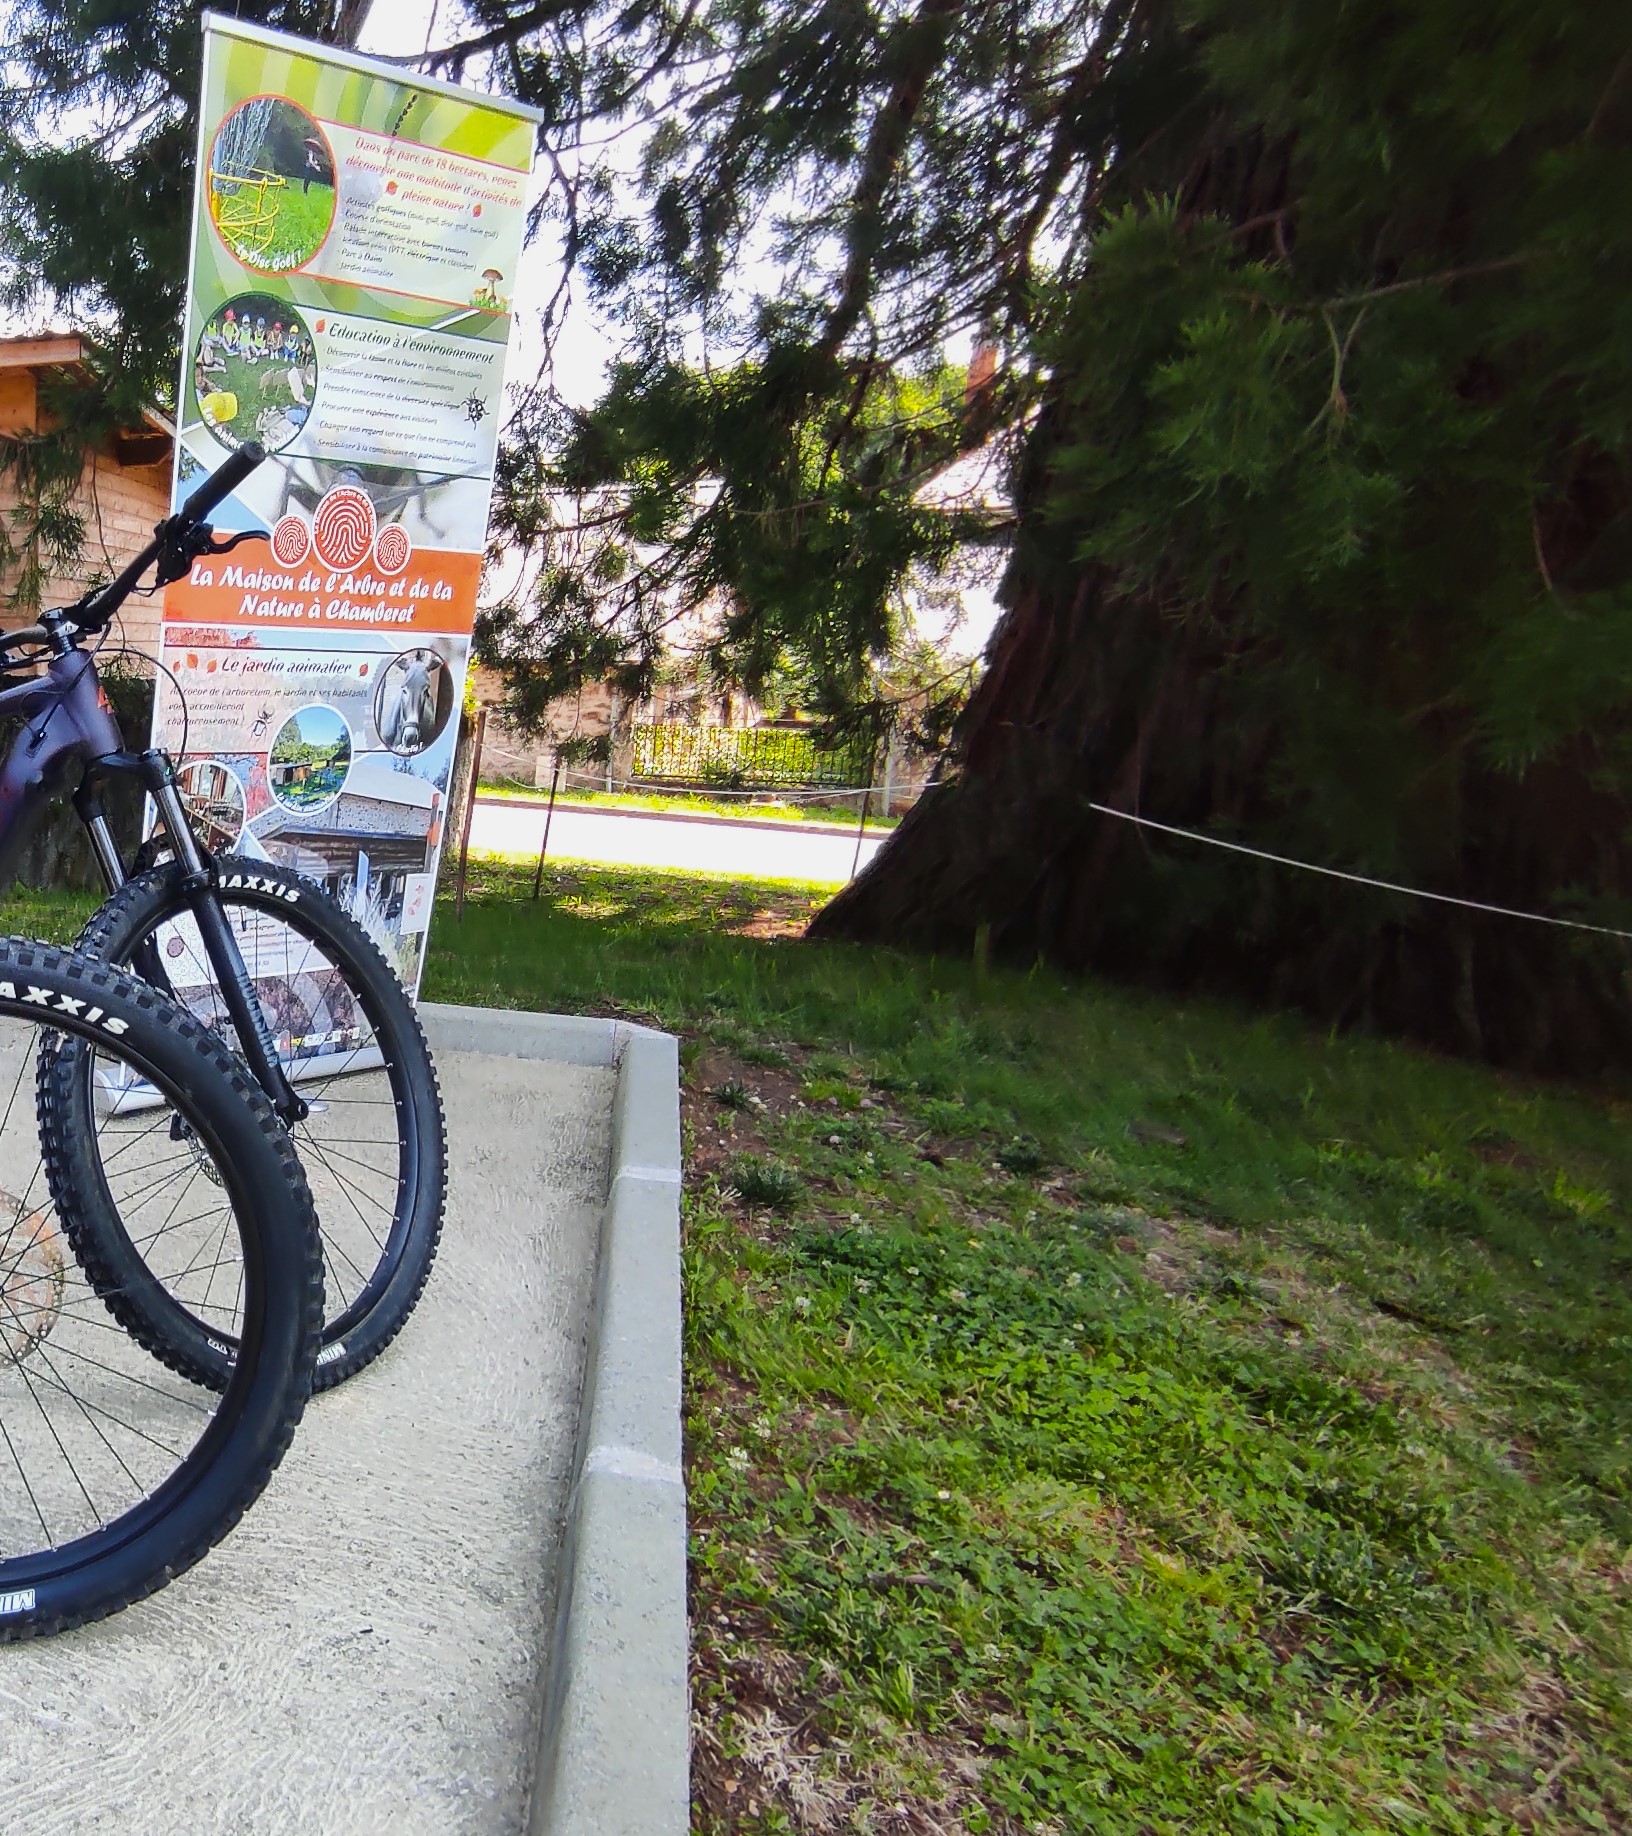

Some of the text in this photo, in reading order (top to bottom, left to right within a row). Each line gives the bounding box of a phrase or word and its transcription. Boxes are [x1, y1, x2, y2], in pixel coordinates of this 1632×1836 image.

[355, 136, 380, 153] Dans
[397, 151, 419, 164] parc
[422, 155, 433, 166] de
[436, 157, 447, 171] 18
[492, 175, 518, 189] venez
[396, 169, 415, 181] une
[417, 174, 462, 194] multitude
[464, 184, 509, 204] d'activités
[510, 196, 523, 207] de
[401, 189, 431, 205] pleine
[433, 197, 465, 211] nature
[329, 322, 495, 365] Education à l'environnement
[190, 563, 452, 600] La Maison de l'Arbre et de la
[238, 593, 415, 624] Nature à Chamberet
[221, 656, 352, 676] Le jardin animalier
[209, 687, 220, 695] de
[282, 688, 306, 698] jardin
[317, 1342, 348, 1366] MINI
